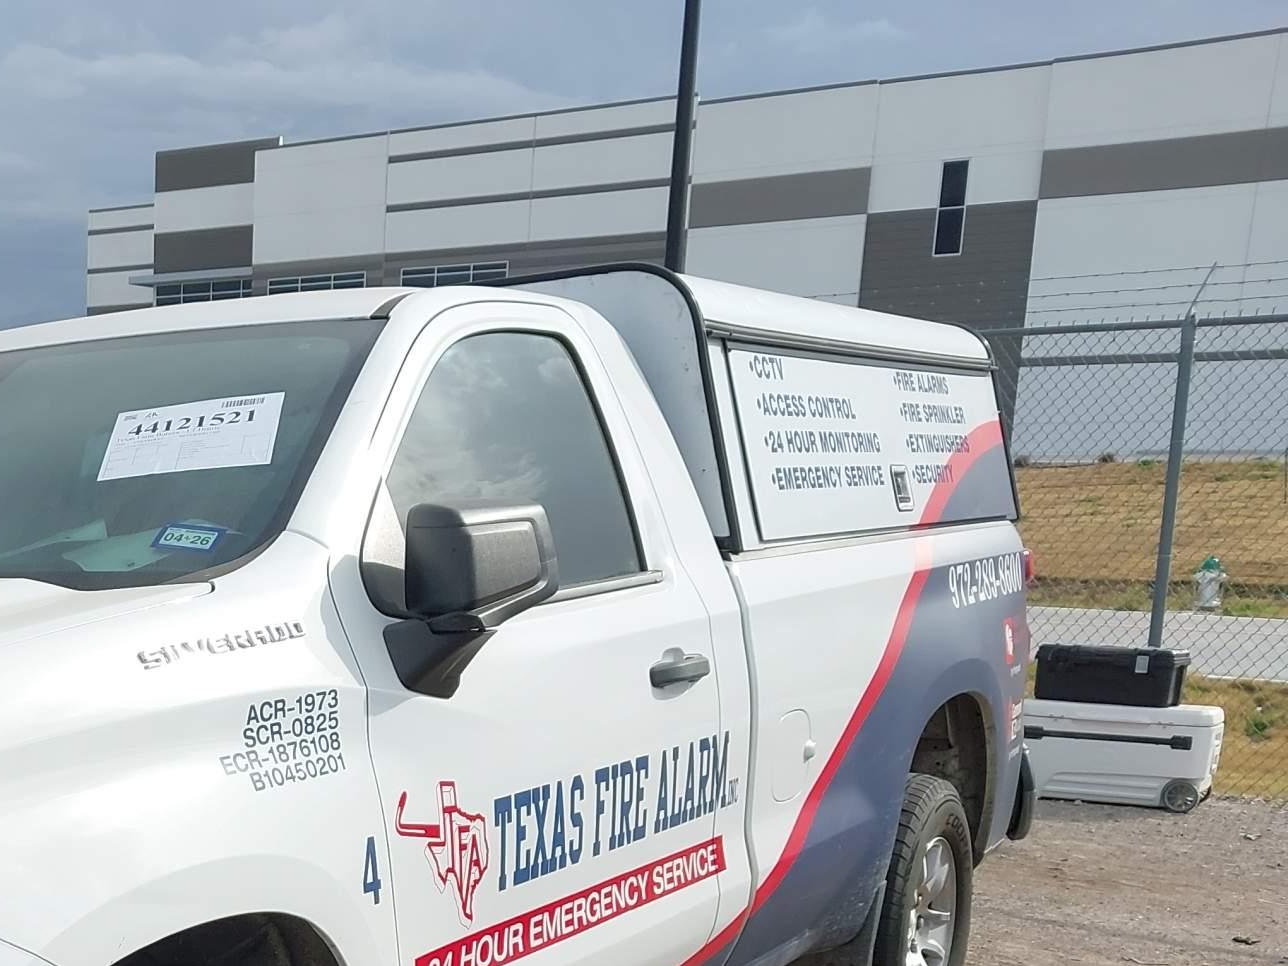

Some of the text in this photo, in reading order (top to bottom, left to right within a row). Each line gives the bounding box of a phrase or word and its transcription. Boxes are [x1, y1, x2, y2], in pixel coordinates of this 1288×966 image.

[753, 354, 784, 381] CCTV
[896, 371, 949, 395] FIRE ALARMS
[762, 394, 856, 420] ACCESS CONTROL
[903, 402, 966, 424] FIRE SPRINKLER
[128, 408, 256, 437] 44121521
[768, 431, 881, 453] 24 HOUR MONITORING
[909, 433, 970, 453] EXTINGUISHERS
[776, 464, 885, 490] EMERGENCY SERVICE
[914, 464, 954, 484] SECURITY
[948, 552, 1022, 608] 972-289-8600
[246, 689, 339, 725] ACR-1973
[243, 711, 339, 748] SCR-0825
[219, 731, 341, 776] ECR-1876108
[250, 752, 347, 792] B10450201
[494, 774, 584, 891] TEXAS
[592, 755, 649, 856] FIRE
[654, 731, 729, 834] ALARM
[363, 836, 382, 905] 4
[529, 872, 649, 947] EMERGENCY
[652, 844, 718, 894] SERVICE
